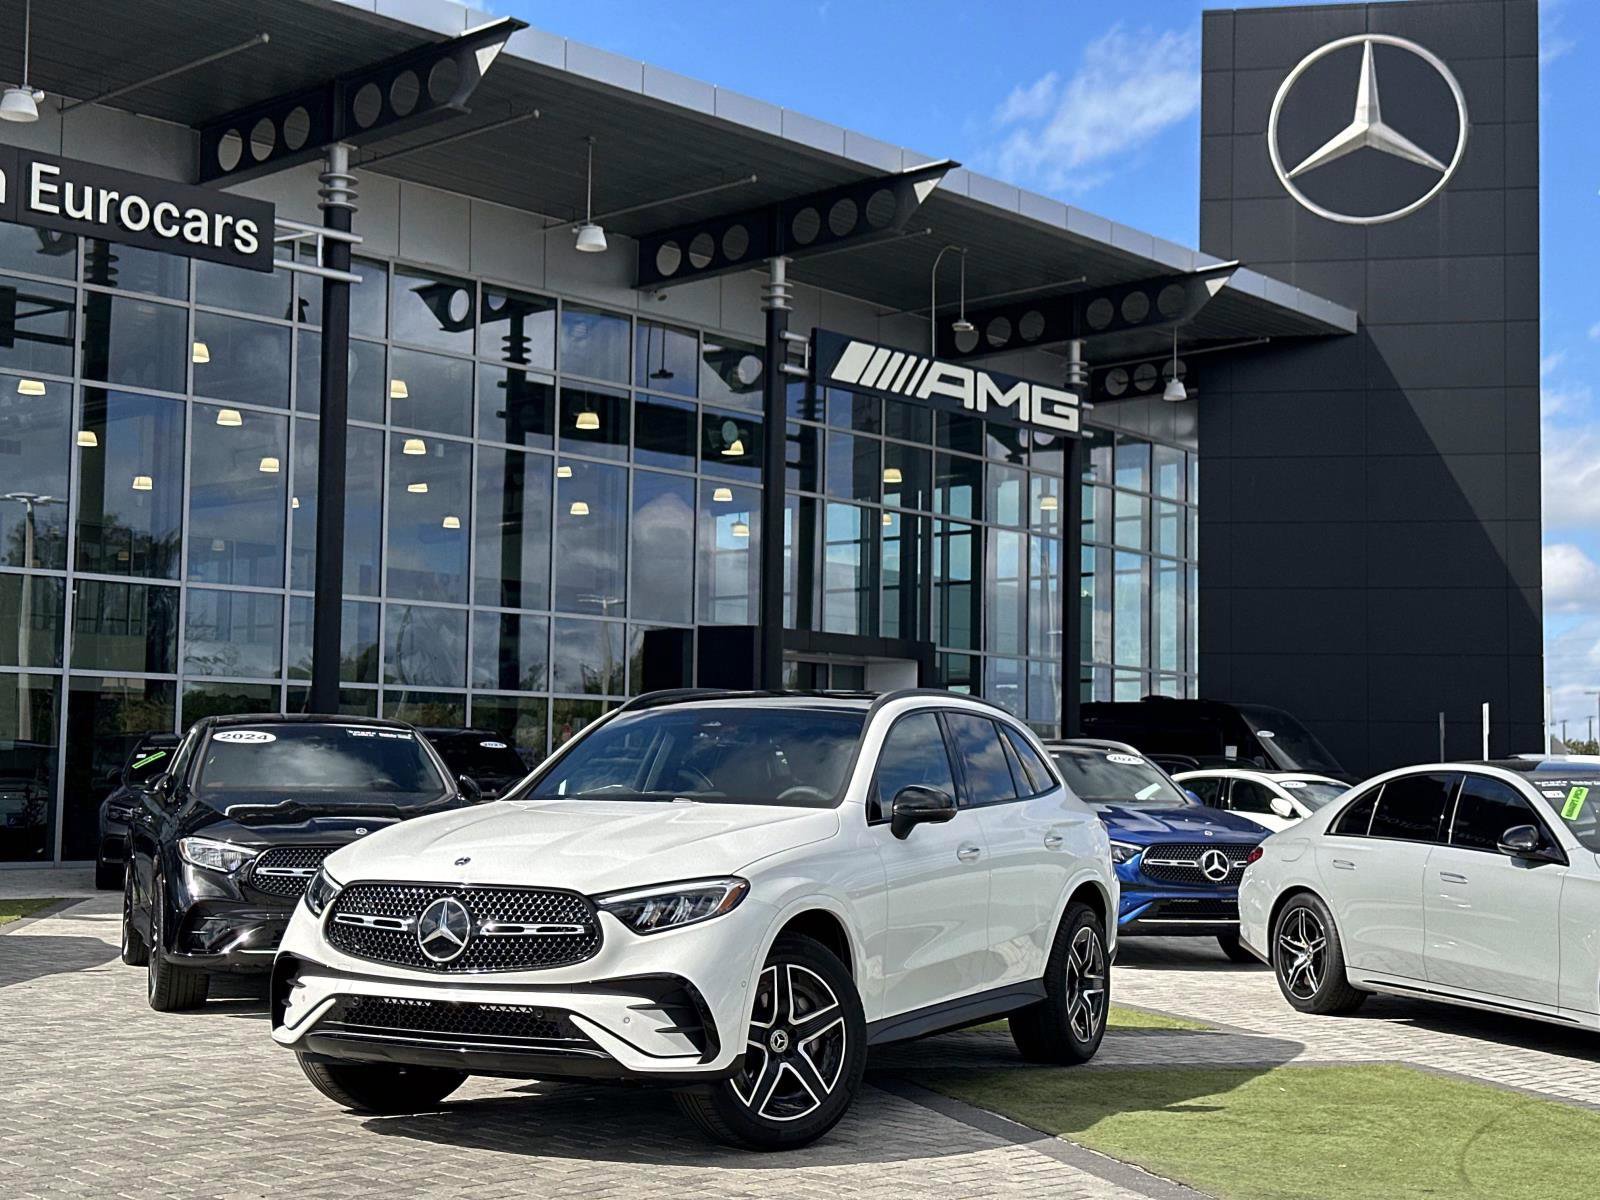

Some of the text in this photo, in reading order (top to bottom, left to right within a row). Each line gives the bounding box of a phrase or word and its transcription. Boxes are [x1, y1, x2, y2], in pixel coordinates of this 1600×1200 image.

[30, 161, 259, 254] Eurocars
[916, 360, 1079, 432] AMG
[220, 733, 268, 741] 2024
